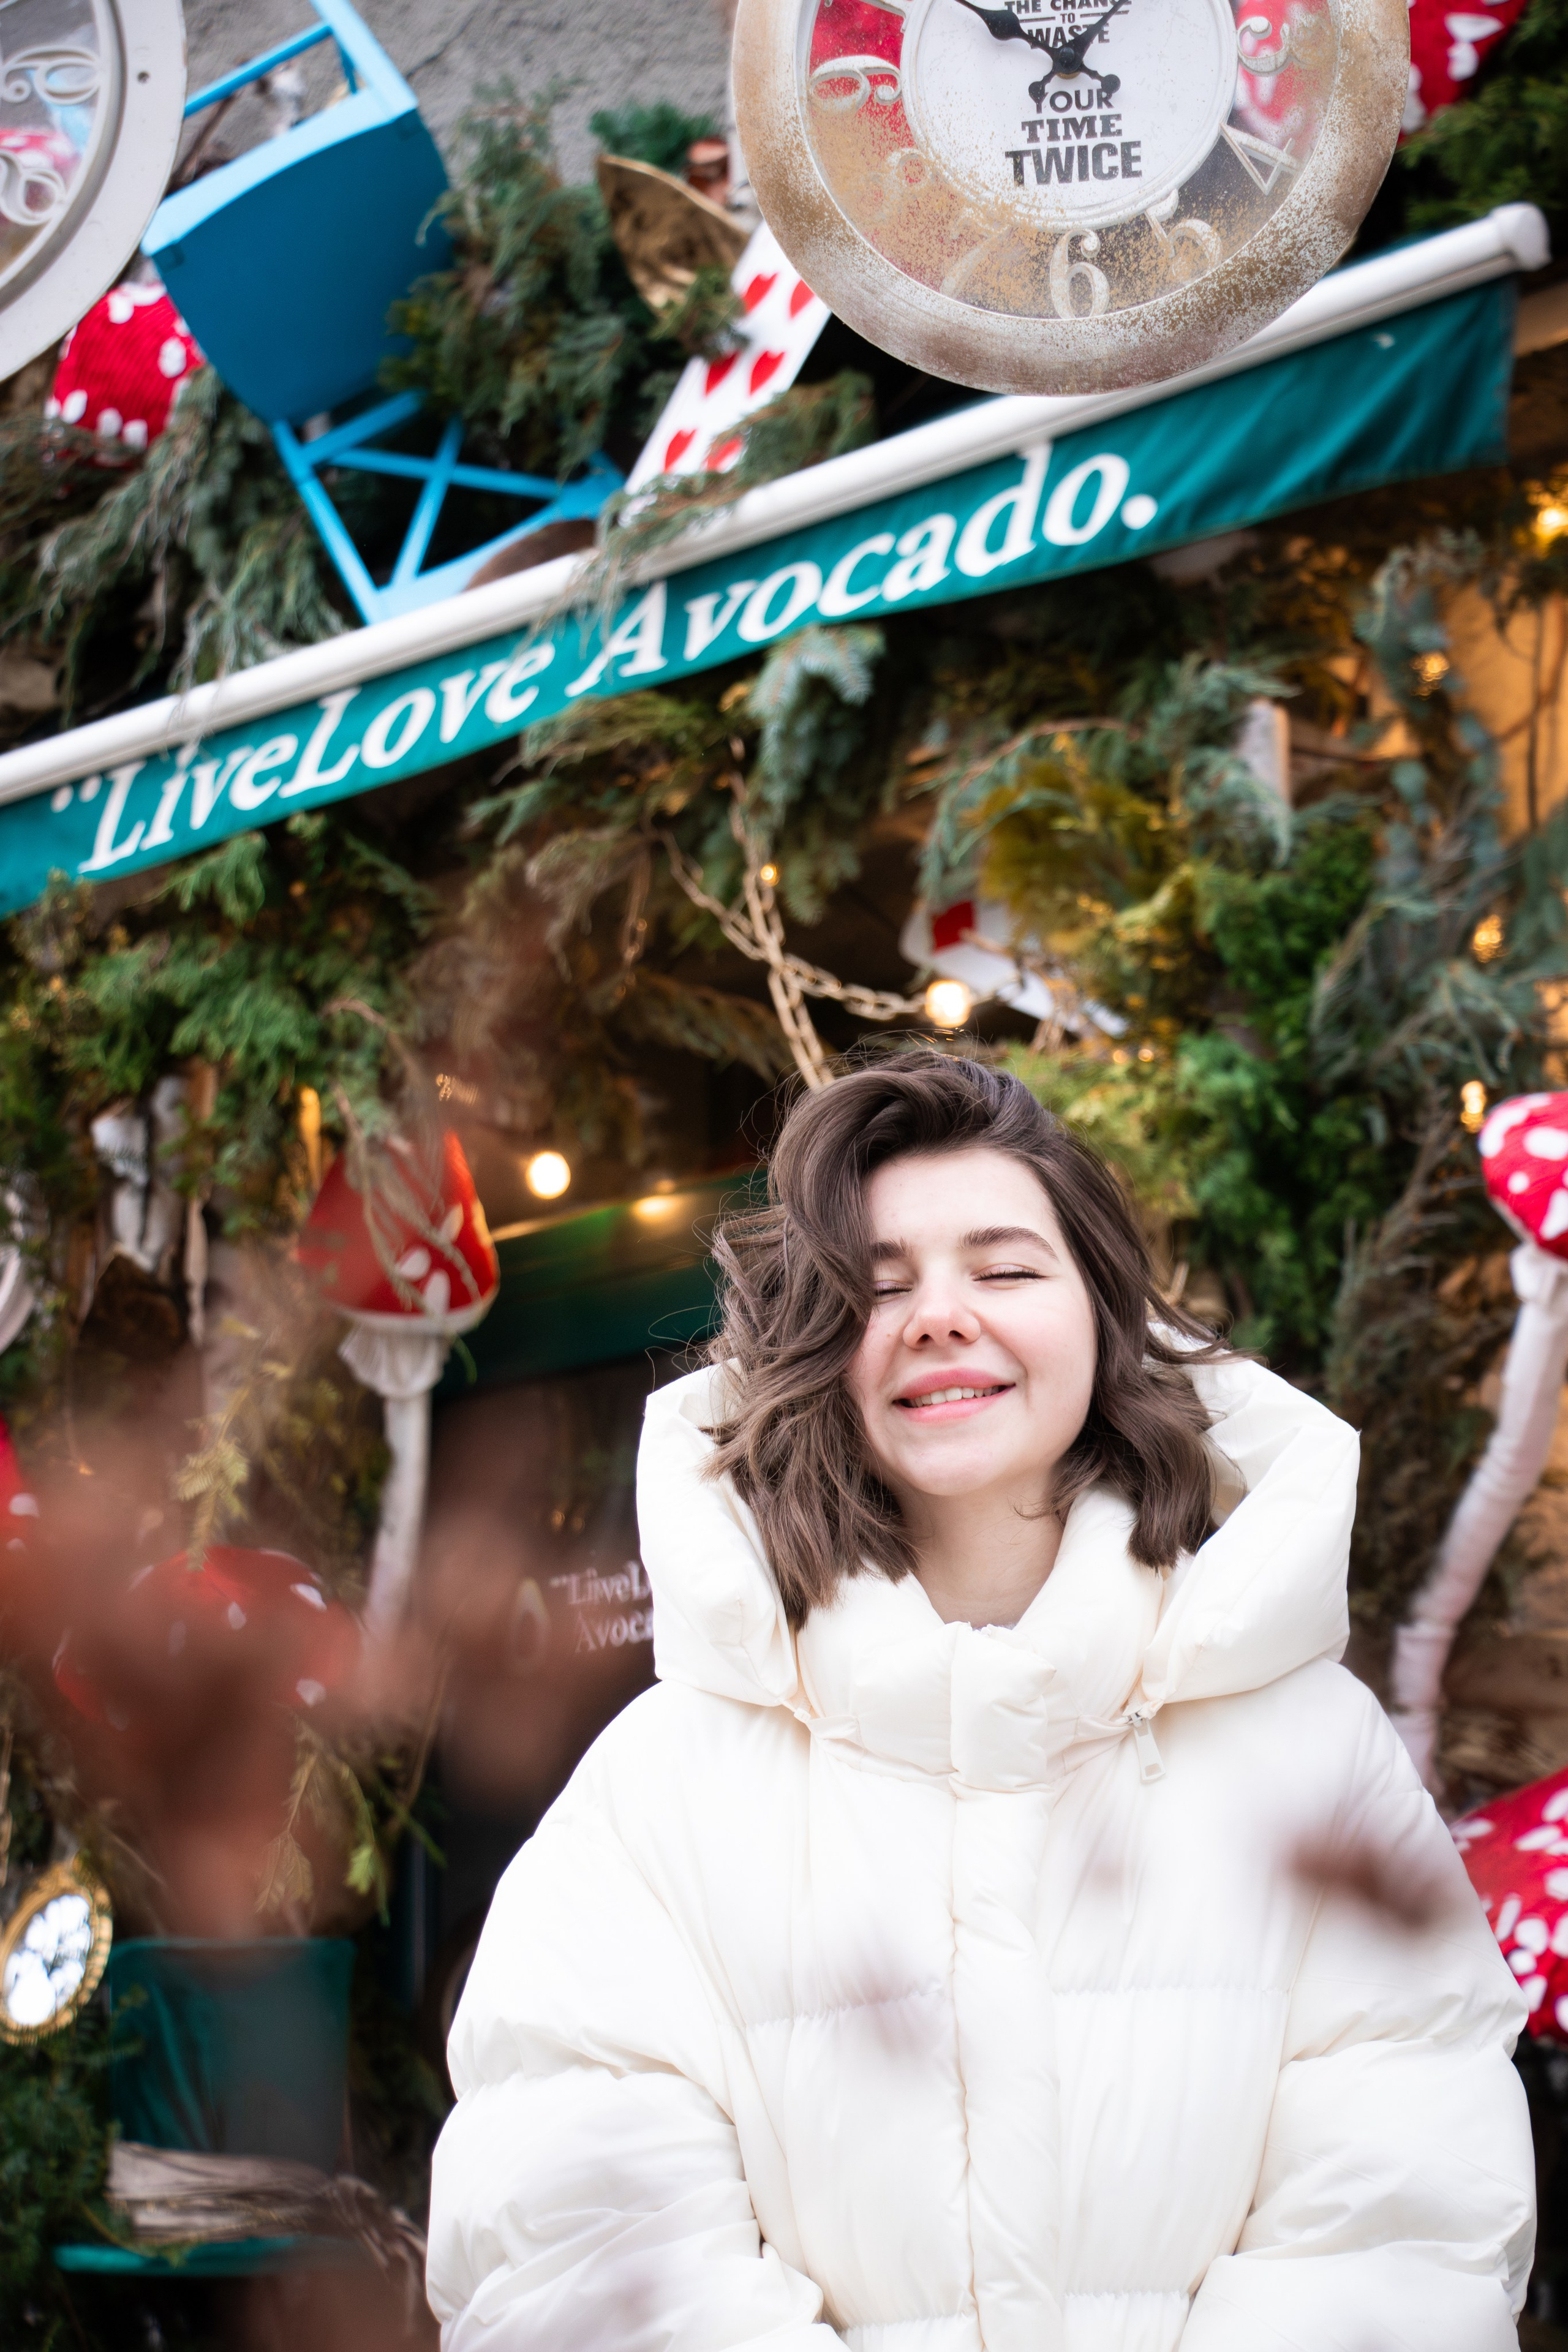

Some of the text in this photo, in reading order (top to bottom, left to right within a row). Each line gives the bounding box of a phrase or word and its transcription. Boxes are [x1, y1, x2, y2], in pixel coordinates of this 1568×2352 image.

[1004, 0, 1132, 14] THE CHAN
[1060, 12, 1076, 24] TO
[1028, 23, 1110, 49] WASE
[1028, 88, 1115, 115] YOUR
[1020, 113, 1123, 144] TIME
[1005, 140, 1143, 187] TWICE
[565, 439, 1159, 698] Avocado.
